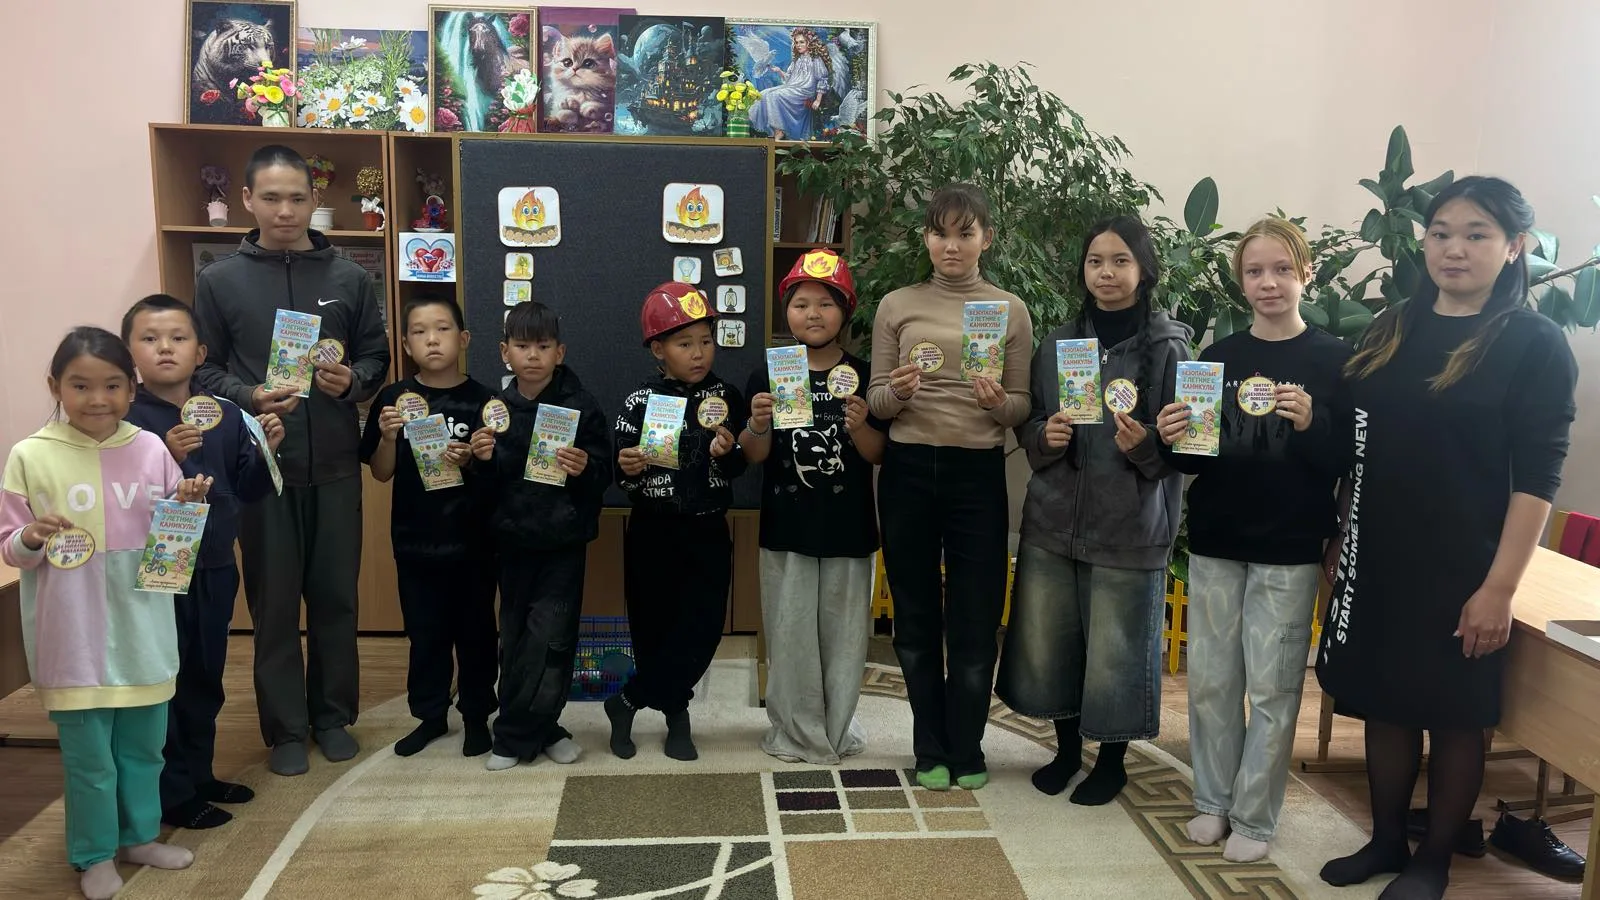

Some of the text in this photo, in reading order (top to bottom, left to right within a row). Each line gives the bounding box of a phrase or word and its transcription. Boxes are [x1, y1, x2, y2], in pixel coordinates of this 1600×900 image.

[643, 474, 672, 488] ANDA
[159, 521, 197, 531] КАНИКУЛЫ
[1336, 408, 1369, 644] START SOMETHING NEW
